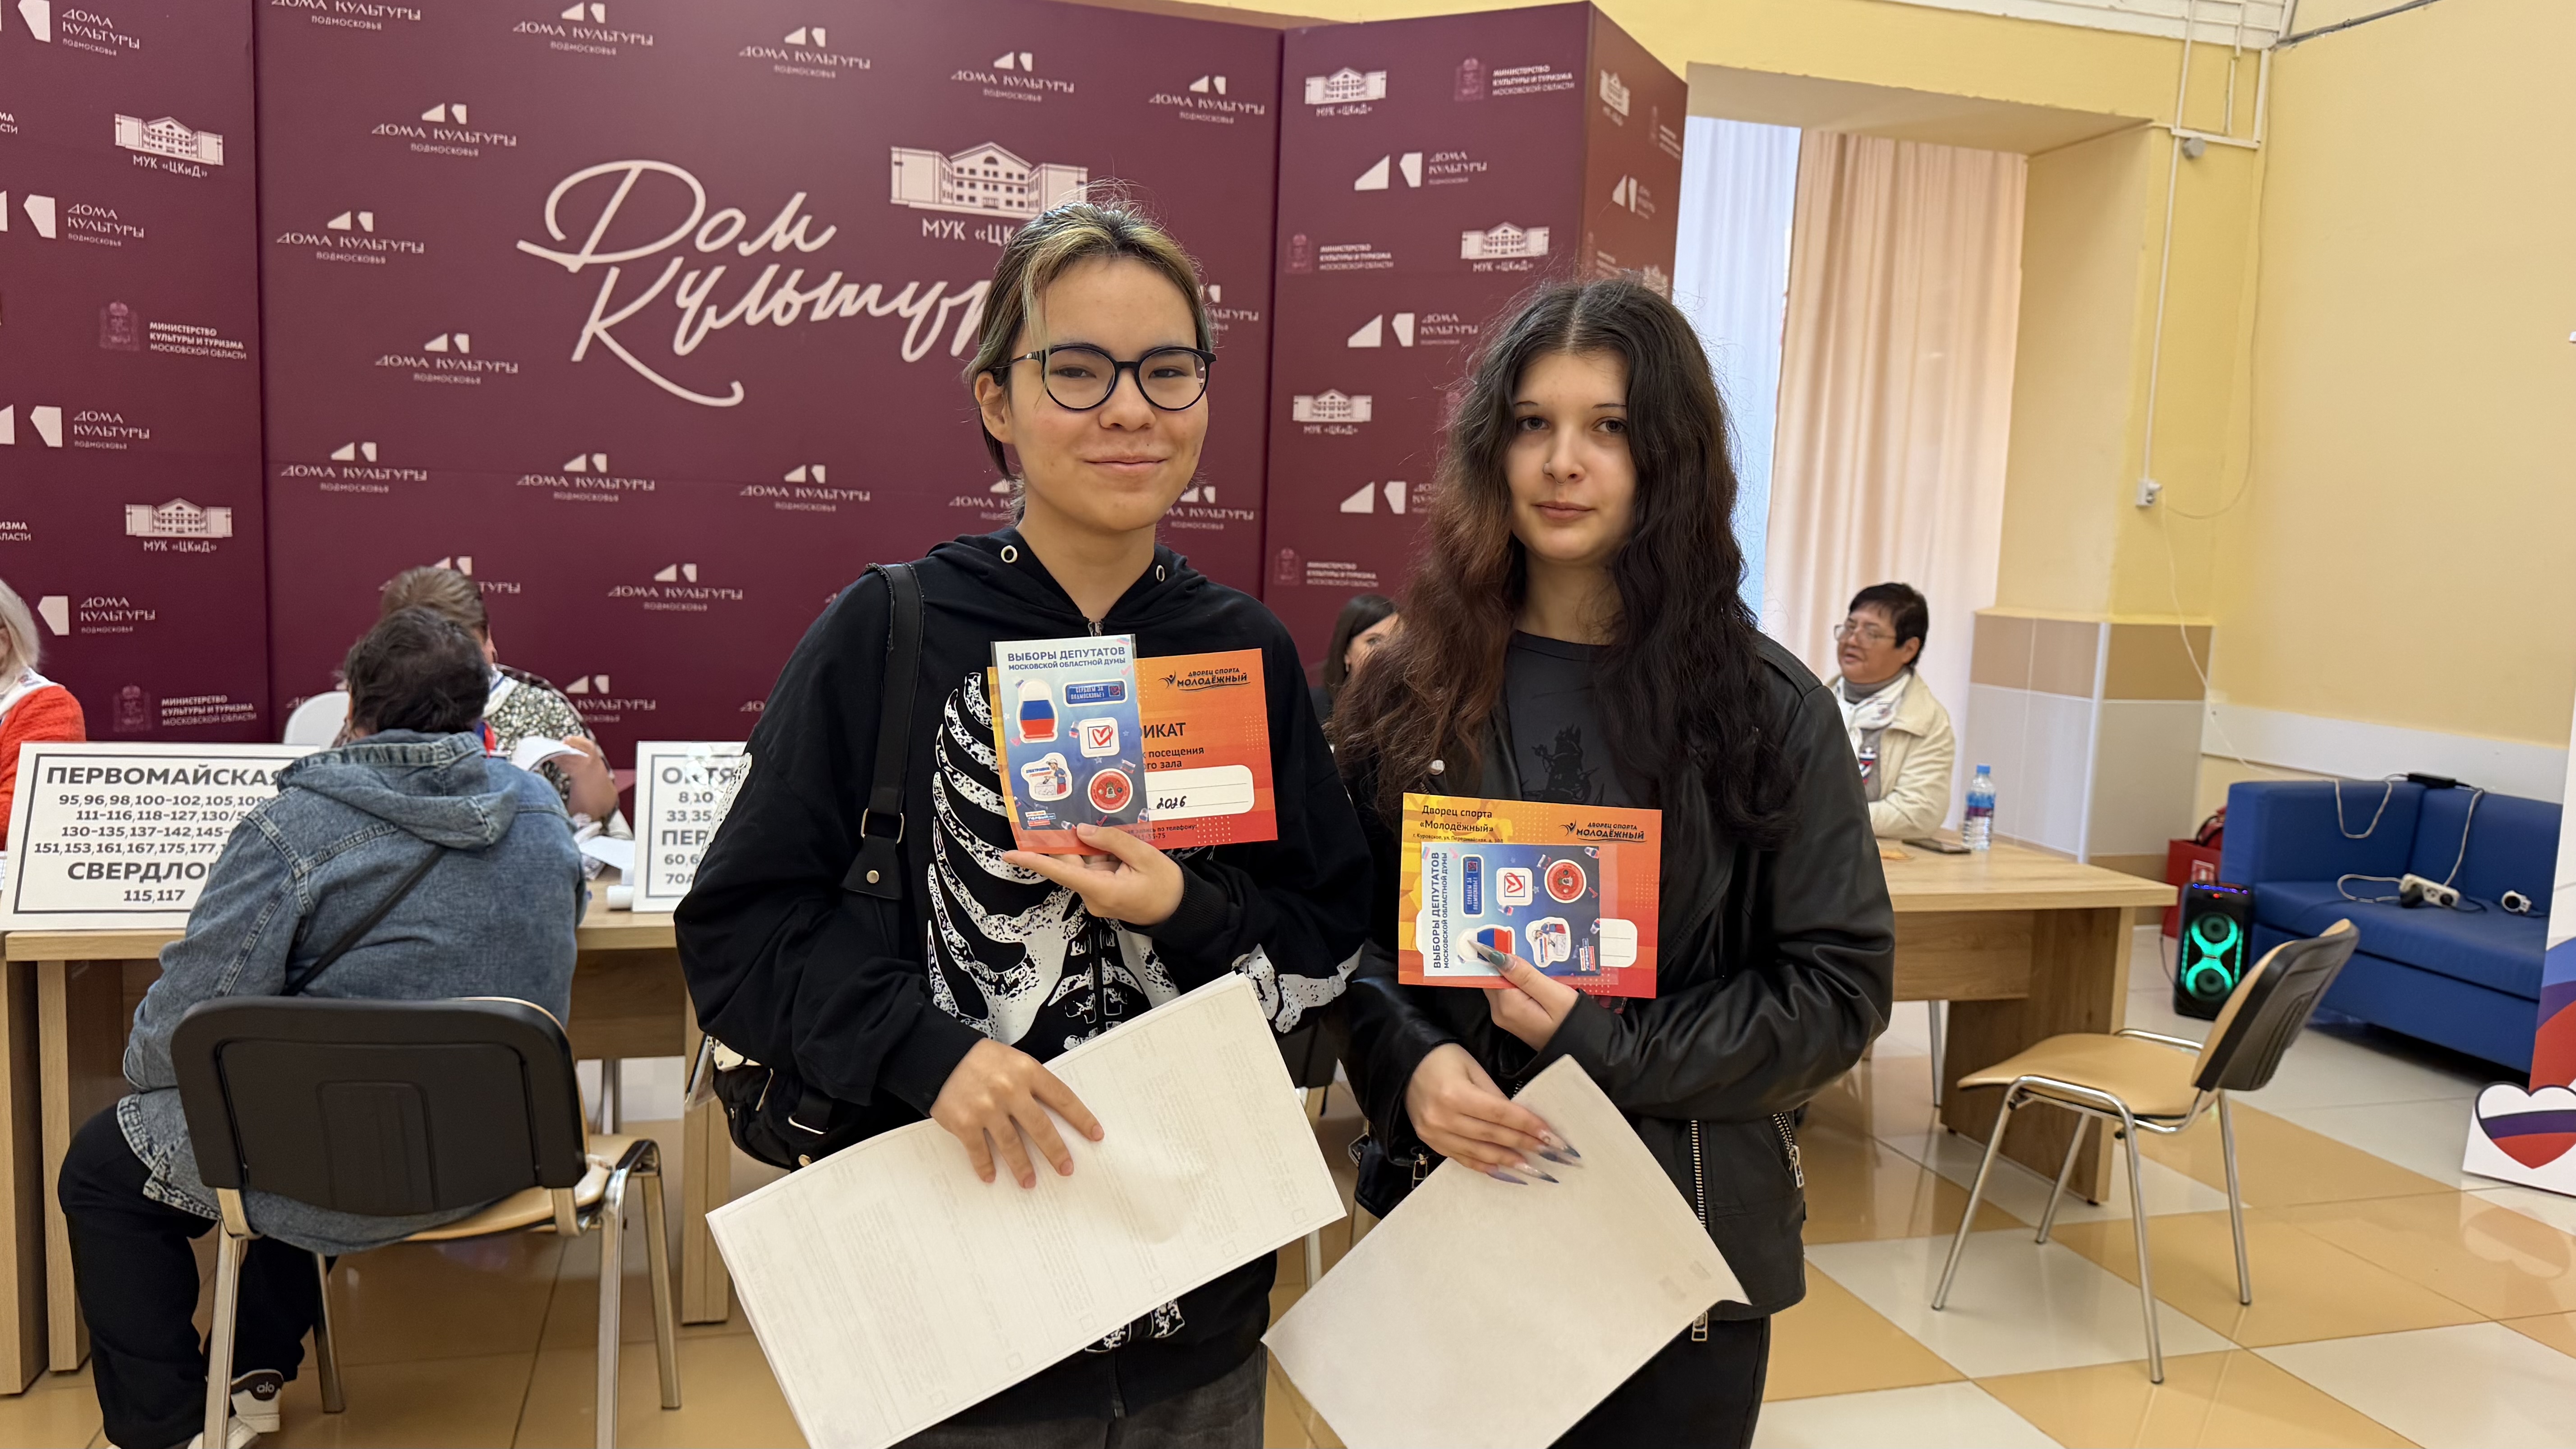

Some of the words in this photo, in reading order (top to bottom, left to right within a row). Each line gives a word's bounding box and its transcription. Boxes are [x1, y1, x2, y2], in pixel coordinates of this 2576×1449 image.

[62, 9, 114, 28] ДОМА
[272, 0, 327, 11] ДОМА
[336, 1, 421, 21] КУЛЬТУРЫ
[312, 15, 382, 31] ПОДМОСКОВЬЯ
[62, 21, 140, 49] КУЛЬТУРЫ
[513, 21, 566, 37] ДОМА
[572, 26, 653, 46] КУЛЬТУРЫ
[739, 46, 788, 61] ДОМА
[795, 50, 870, 69] КУЛЬТУРЫ
[951, 70, 997, 84] ДОМА
[1002, 74, 1074, 93] КУЛЬТУРЫ
[1148, 93, 1194, 108] ДОМА
[1198, 97, 1265, 115] КУЛЬТУРЫ
[372, 123, 427, 139] ДОМА
[433, 128, 517, 147] КУЛЬТУРЫ
[133, 154, 158, 170] МУК
[68, 203, 118, 220] ДОМА
[517, 160, 837, 273] Дом
[68, 216, 144, 239] КУЛЬТУРЫ
[922, 218, 966, 240] МУК
[277, 232, 332, 247] ДОМА
[339, 236, 424, 254] КУЛЬТУРЫ
[375, 354, 429, 368] ДОМА
[436, 357, 519, 374] КУЛЬТУРЫ
[74, 411, 124, 424] ДОМА
[74, 423, 150, 439] КУЛЬТУРЫ
[281, 465, 336, 479] ДОМА
[343, 467, 428, 481] КУЛЬТУРЫ
[516, 474, 569, 487] ДОМА
[575, 476, 655, 491] КУЛЬТУРЫ
[740, 485, 790, 497] ДОМА
[795, 486, 871, 502] КУЛЬТУРЫ
[948, 496, 994, 508] ДОМА
[143, 540, 168, 552] МУК
[607, 585, 659, 598] ДОМА
[665, 586, 743, 601] КУЛЬТУРЫ
[80, 596, 130, 608] ДОМА
[80, 609, 156, 621] КУЛЬТУРЫ
[1008, 651, 1056, 662] ВЫБОРЫ
[1060, 647, 1125, 660] ДЕПУТАТОВ
[1008, 661, 1058, 671] МОСКОВСКОЙ
[1059, 658, 1103, 668] ОБЛАСТНОЙ
[1104, 658, 1126, 666] ДУМЫ
[1177, 672, 1247, 687] МОЛОДЁЖНЫЙ
[1188, 669, 1213, 677] ДВОРЕЦ
[1149, 747, 1205, 758] посещения
[1160, 760, 1182, 769] зала
[1422, 805, 1458, 817] Дворец
[1460, 810, 1492, 820] спорта
[1420, 819, 1494, 833] «Молодёжный»
[1576, 828, 1644, 839] МОЛОДЁЖНЫЙ
[68, 862, 216, 883] СВЕРДЛО
[1431, 852, 1440, 917] ДЕПУТАТОВ
[124, 889, 185, 904] 115,117
[1432, 920, 1441, 968] ВЫБОРЫ
[1441, 920, 1449, 969] МОСКОВСКОЙ
[257, 1381, 275, 1393] alo
